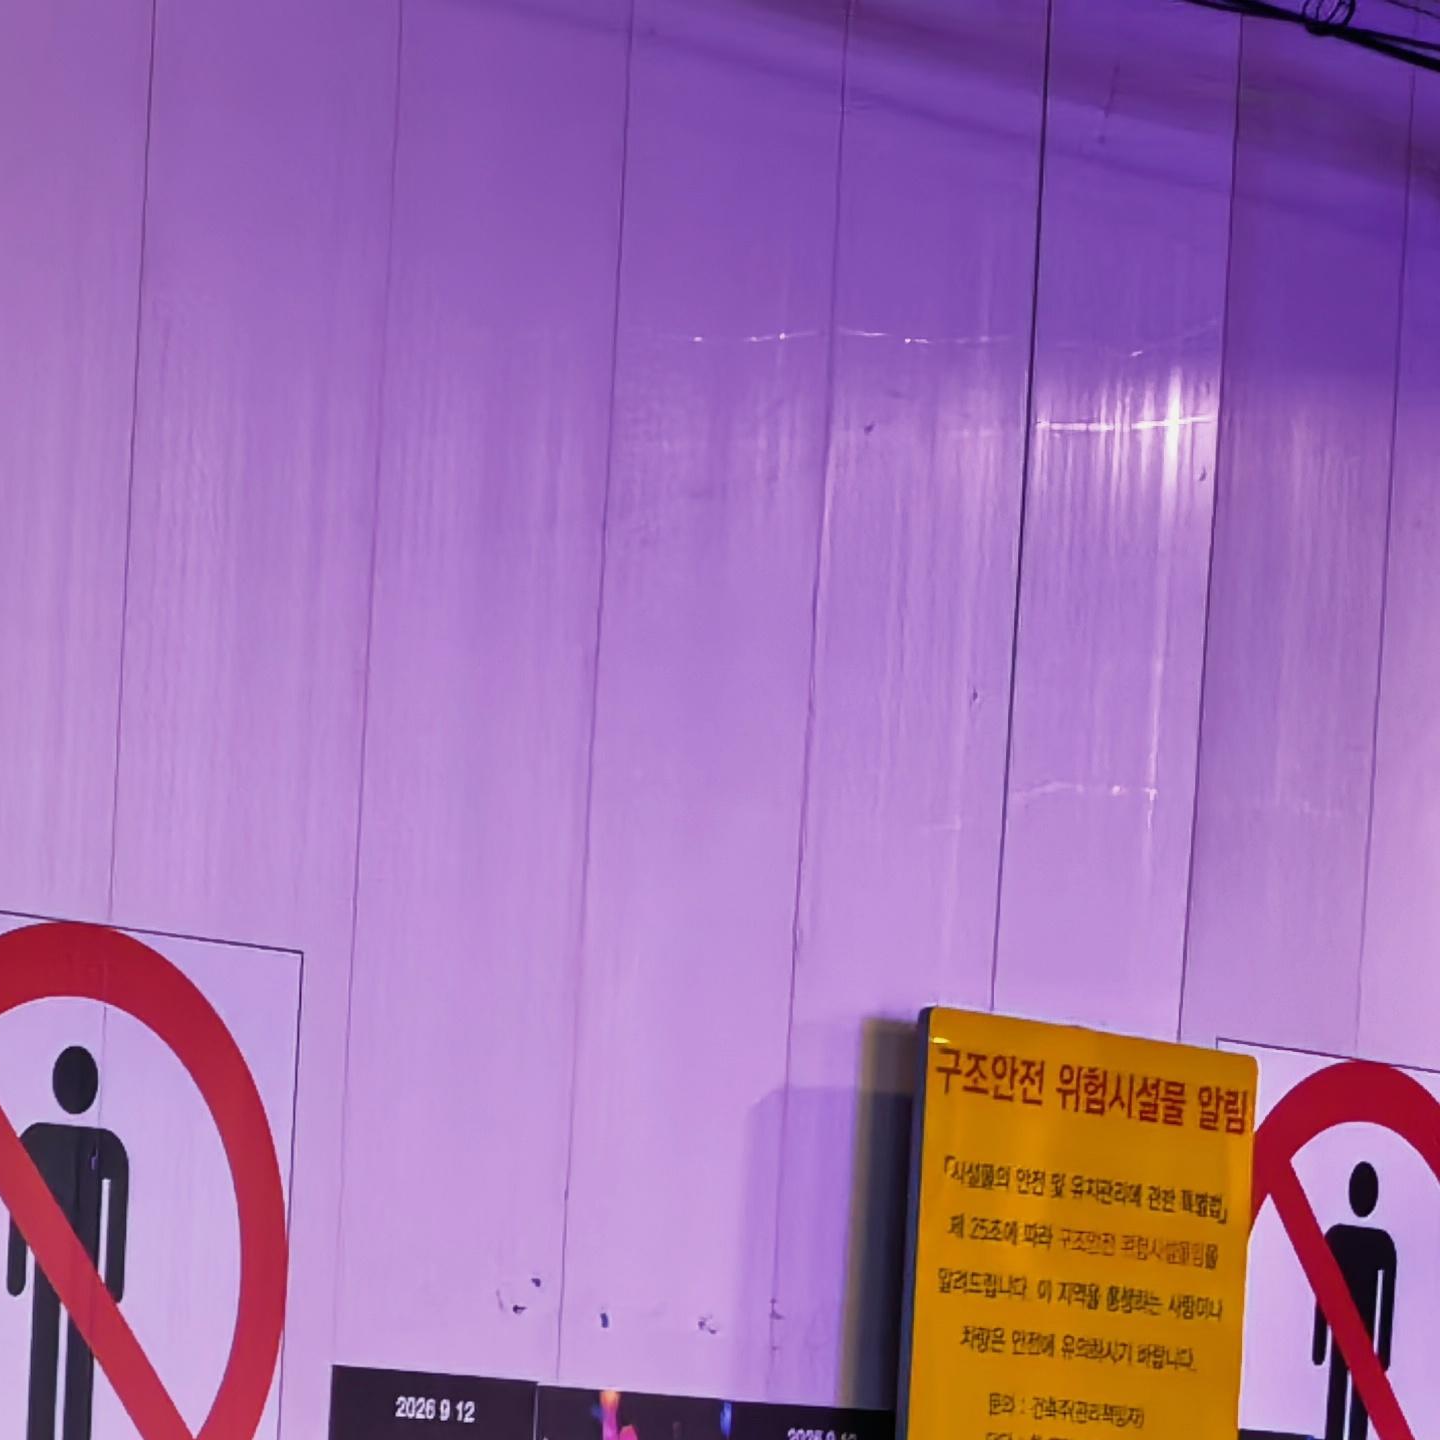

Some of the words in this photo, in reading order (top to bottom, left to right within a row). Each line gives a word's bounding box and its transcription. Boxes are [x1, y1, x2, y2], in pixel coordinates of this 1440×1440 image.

[935, 1047, 1045, 1105] 구조안전
[1056, 1063, 1187, 1126] 위험시설물
[1199, 1086, 1247, 1135] 알림
[395, 1396, 435, 1420] 2026
[440, 1399, 451, 1421] 9
[455, 1401, 475, 1423] 12
